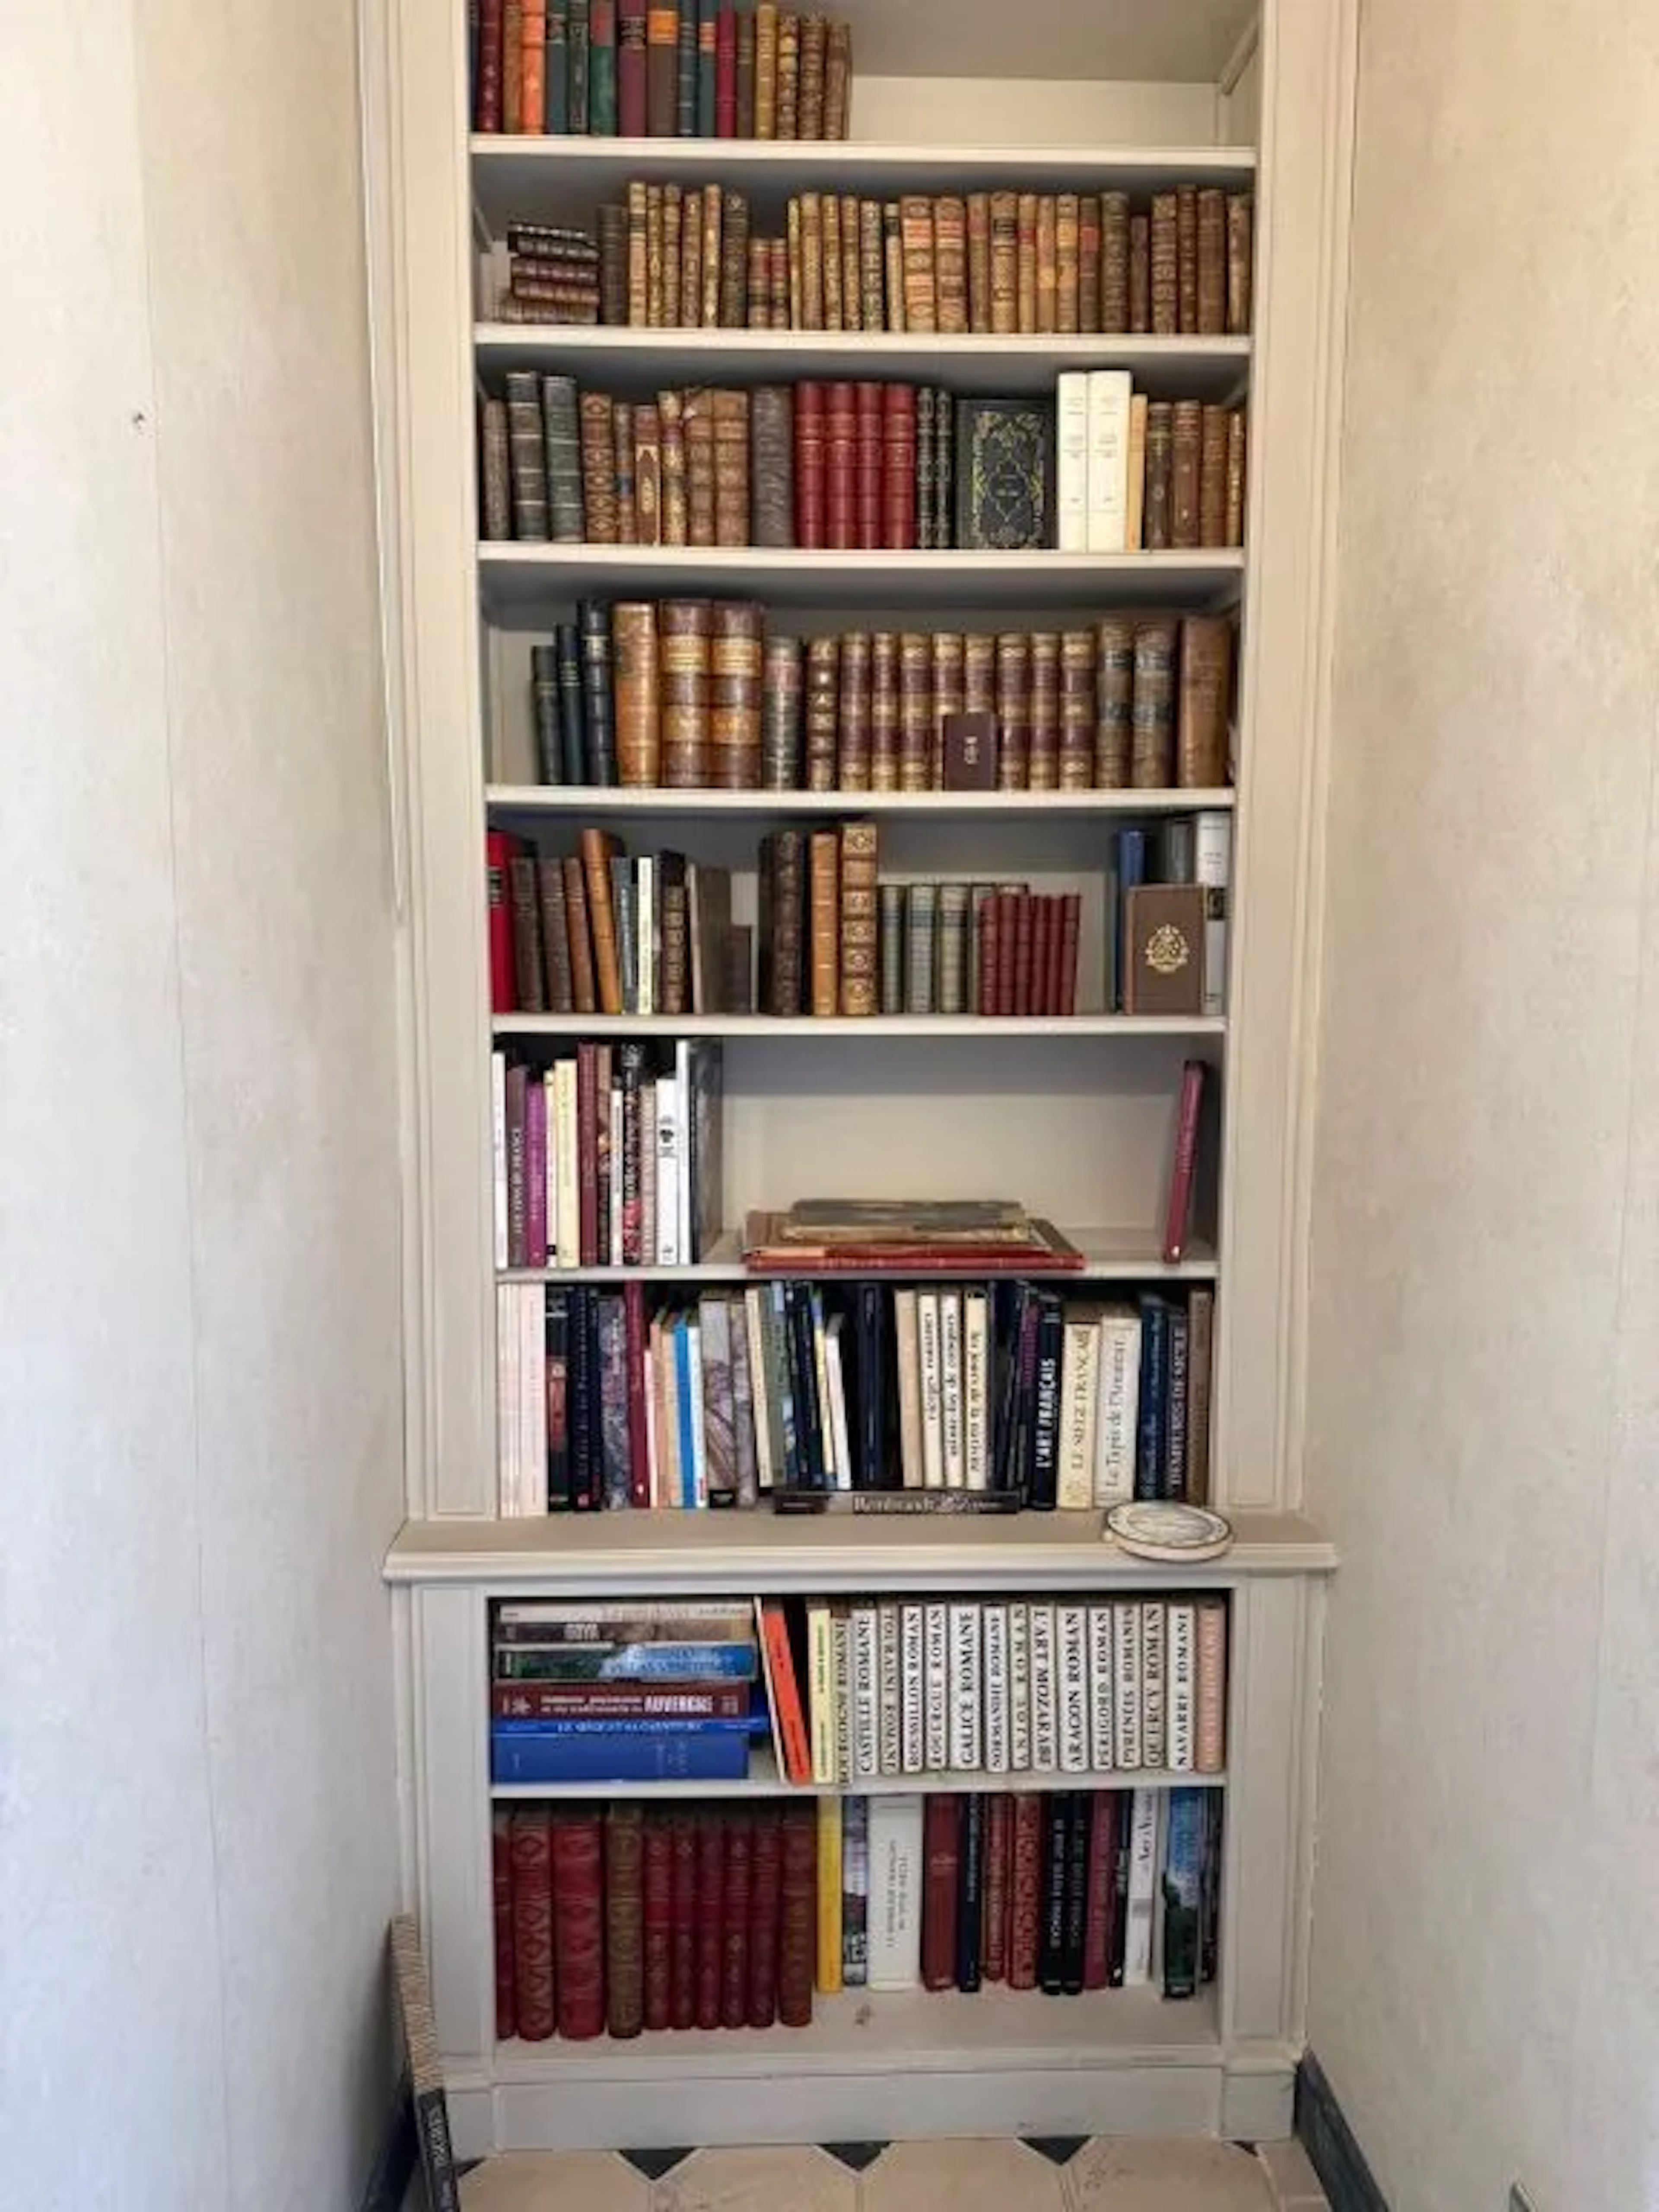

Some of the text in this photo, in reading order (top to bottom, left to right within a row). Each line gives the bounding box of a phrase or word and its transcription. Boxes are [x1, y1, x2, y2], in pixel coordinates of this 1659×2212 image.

[644, 1694, 714, 1713] AUVERGNE
[857, 1617, 873, 1772] CASTILLE ROMANE
[906, 1612, 919, 1766] ROUSSILLON ROMAN
[930, 1610, 942, 1764] ROUERGUE ROMAN
[959, 1612, 975, 1764] GALICE ROMANE
[1014, 1608, 1026, 1684] ROMAN
[1066, 1612, 1081, 1766] ARAGON ROMAN
[1095, 1612, 1107, 1674] ROMAN
[1147, 1608, 1161, 1764] QUERCY ROMAN
[1175, 1613, 1188, 1766] NAVARRE ROMANE
